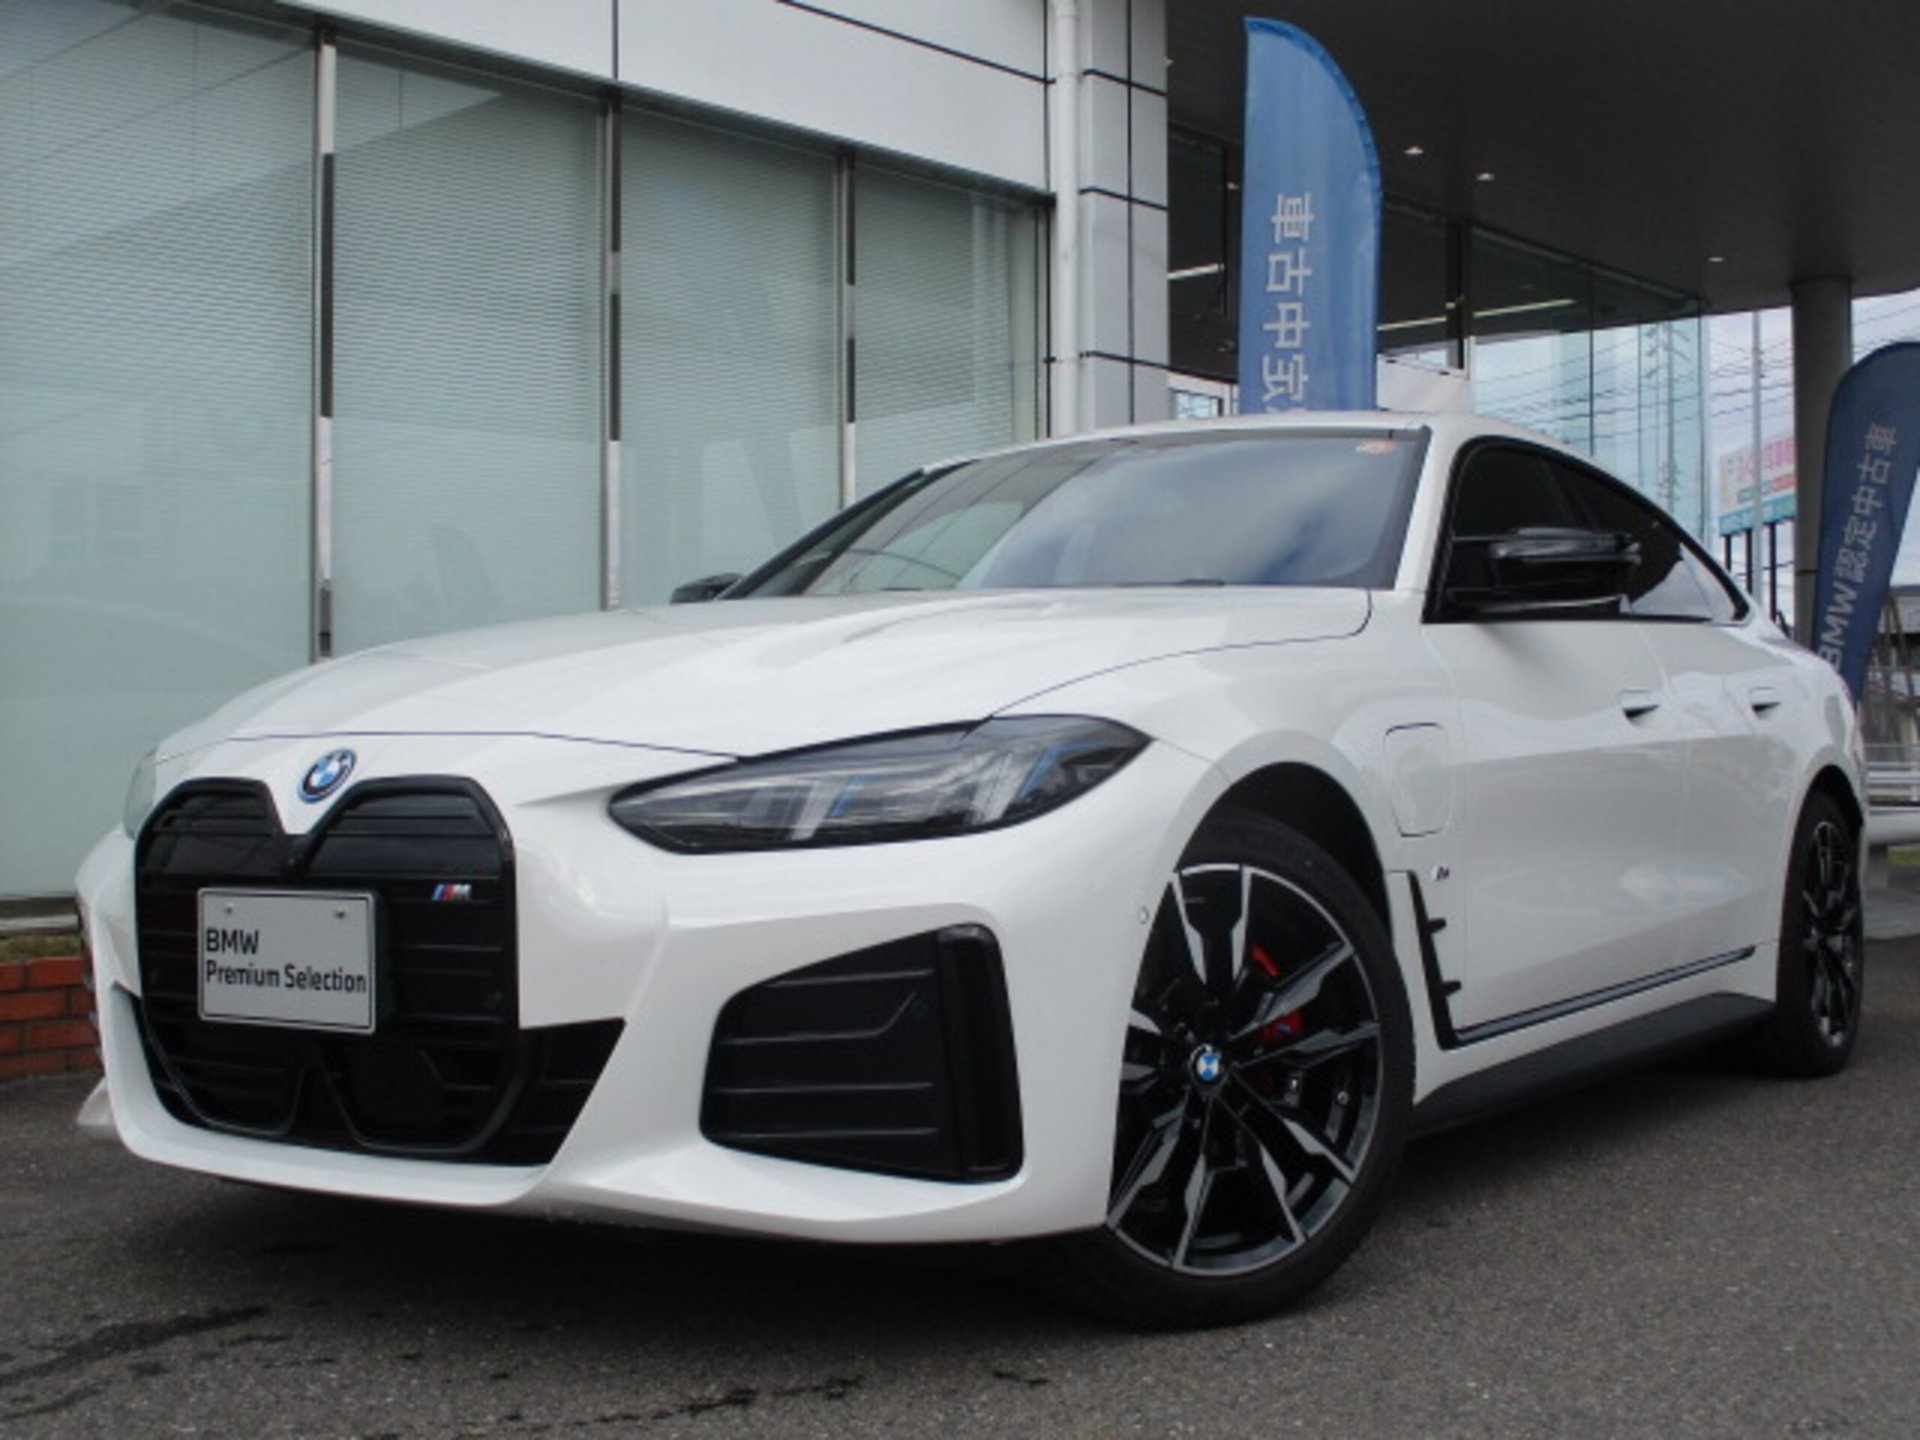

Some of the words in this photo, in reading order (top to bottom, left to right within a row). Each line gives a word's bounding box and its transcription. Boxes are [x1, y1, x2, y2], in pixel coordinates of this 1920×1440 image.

[206, 928, 260, 955] BMW
[206, 959, 280, 988] Premium
[284, 963, 367, 994] Selection
